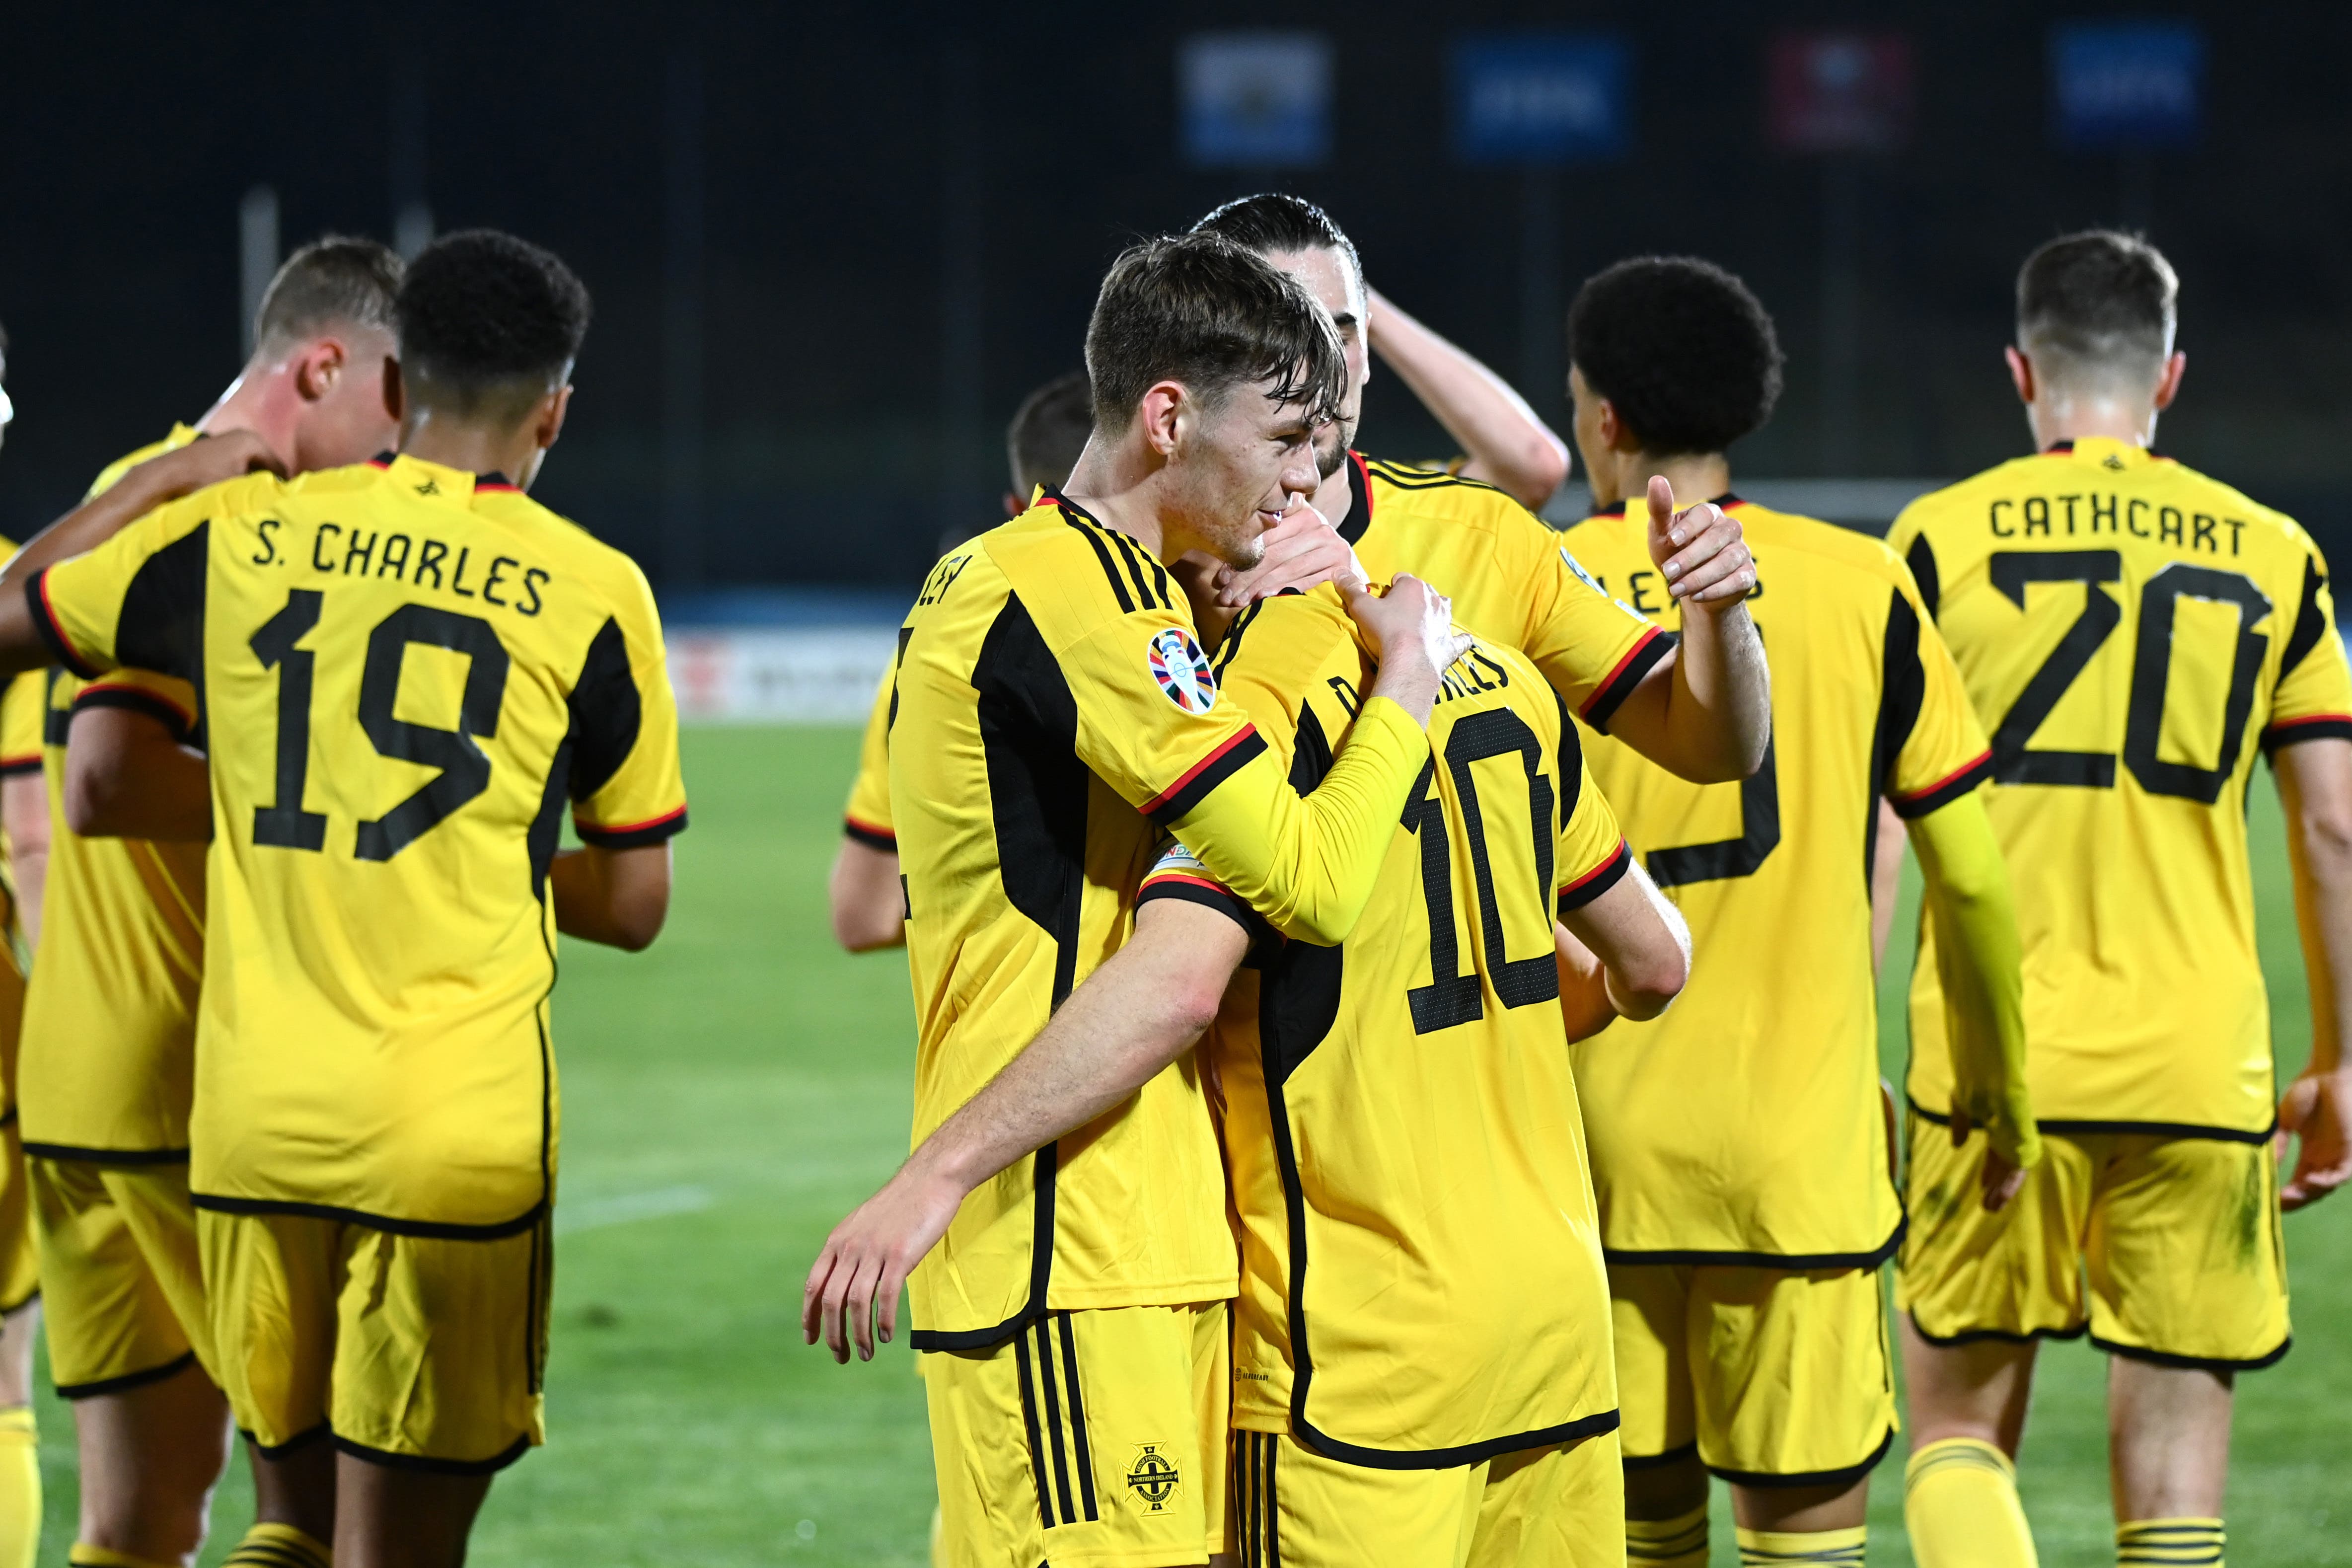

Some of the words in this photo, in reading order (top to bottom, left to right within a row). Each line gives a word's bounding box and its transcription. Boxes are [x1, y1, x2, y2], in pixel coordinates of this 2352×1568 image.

[253, 520, 284, 566] S.
[312, 523, 550, 617] CHARLES
[1990, 494, 2246, 557] CATHCART
[250, 588, 511, 862] 19
[1988, 549, 2273, 805] 20
[1400, 707, 1559, 1036] 10
[1136, 1459, 1145, 1472] IRISH
[1145, 1455, 1168, 1470] FOOTBALL
[1139, 1487, 1170, 1501] ASSOCIATION
